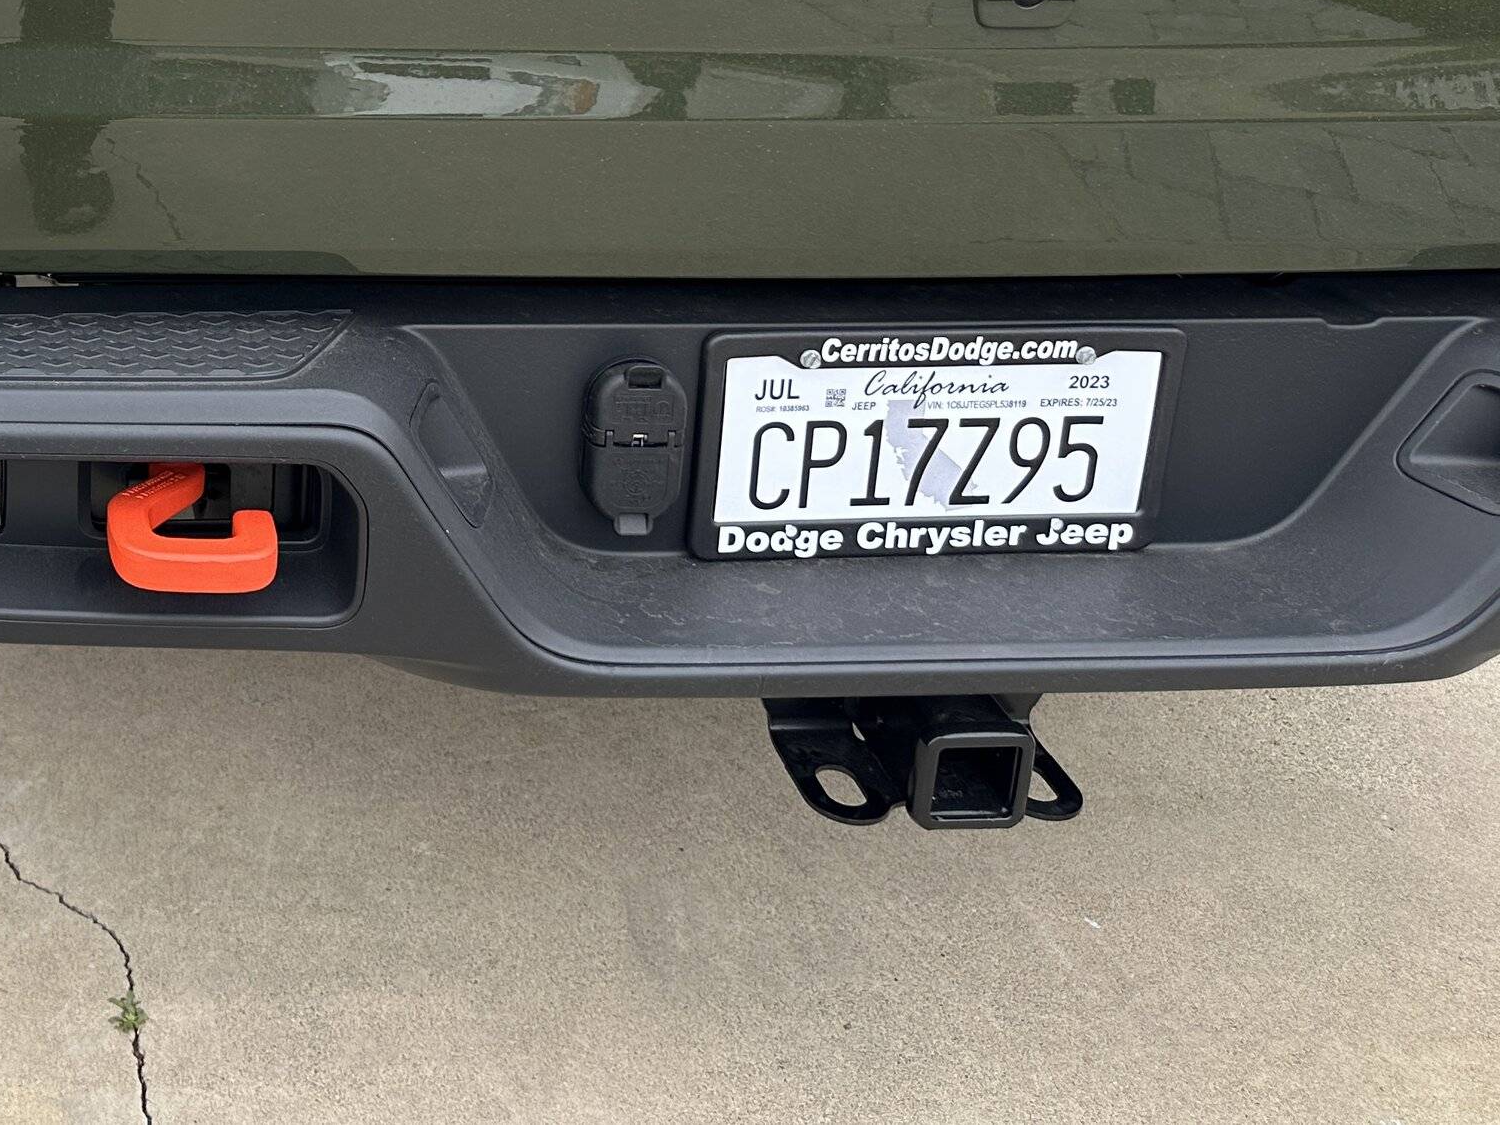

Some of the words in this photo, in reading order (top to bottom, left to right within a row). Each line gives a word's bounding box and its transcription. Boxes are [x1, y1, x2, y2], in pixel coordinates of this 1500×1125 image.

[821, 336, 1078, 365] CerritosDodge.com
[754, 378, 801, 401] JUL
[864, 369, 1010, 410] California
[1069, 375, 1111, 389] 2023
[851, 401, 877, 411] JEEP
[1039, 398, 1083, 408] EXPIRES:
[1085, 397, 1118, 407] 7/25/23
[748, 415, 1105, 511] CP17Z95
[717, 525, 844, 558] Dodge
[856, 520, 1027, 556] Chrysler
[1036, 518, 1134, 551] Jeep
